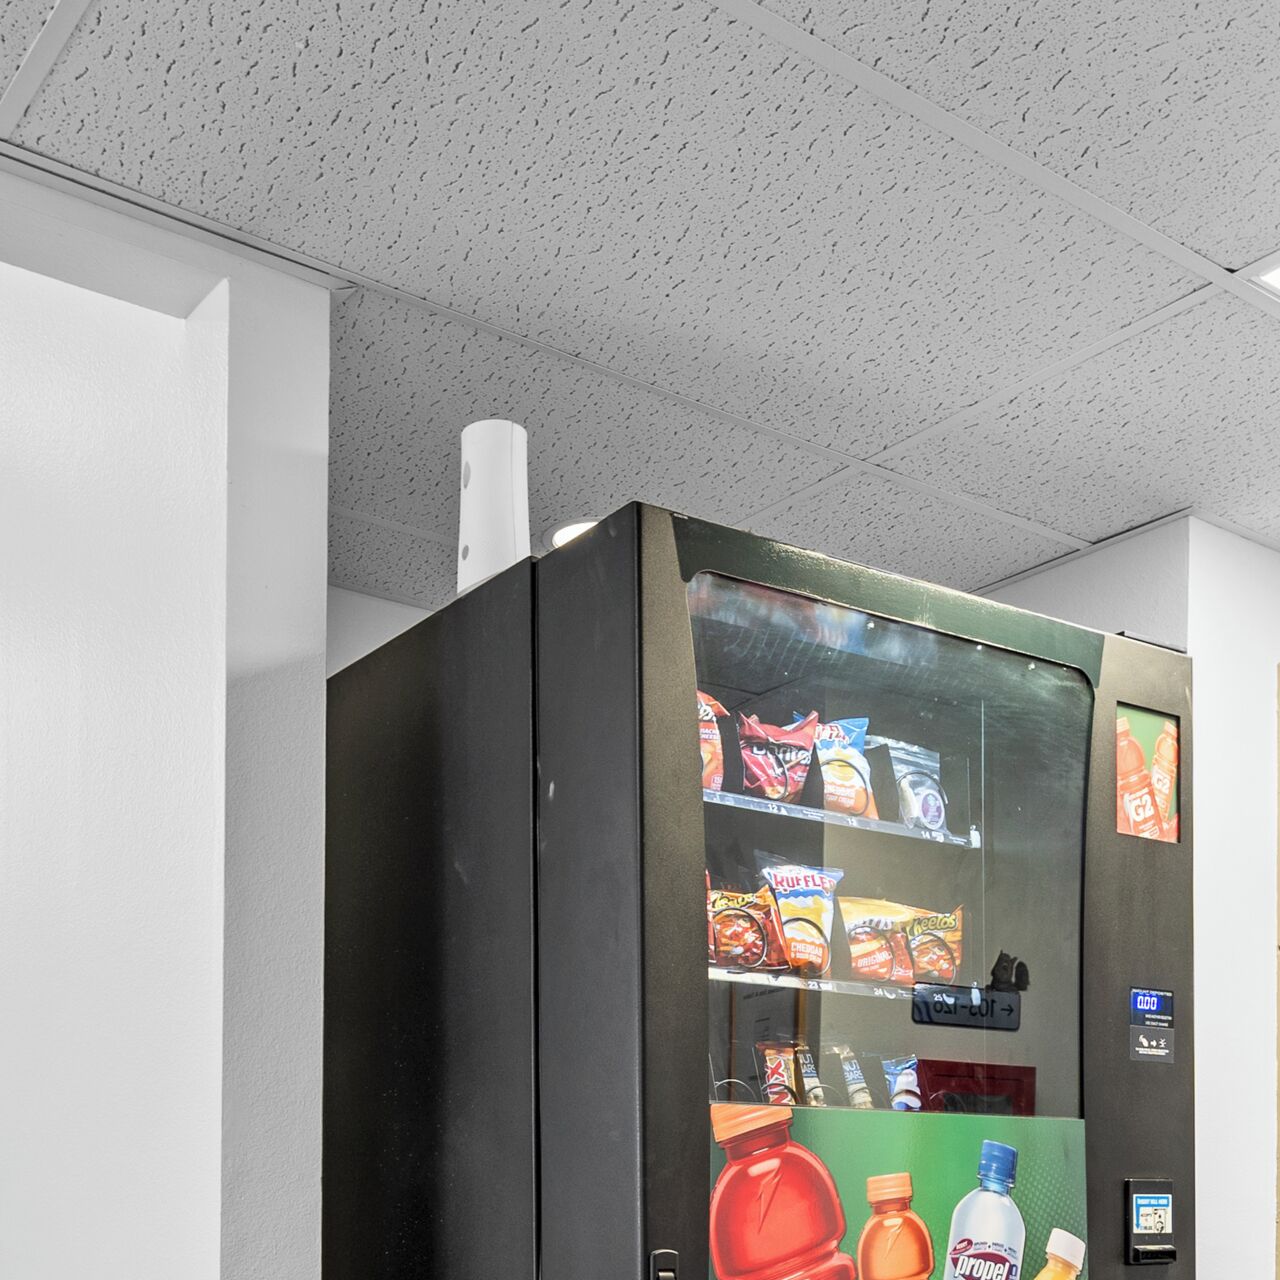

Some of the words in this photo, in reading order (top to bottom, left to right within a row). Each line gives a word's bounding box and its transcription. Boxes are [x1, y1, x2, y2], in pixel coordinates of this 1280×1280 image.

[768, 804, 778, 812] 12
[1130, 793, 1155, 822] G2
[874, 988, 883, 996] 24
[842, 1058, 860, 1071] NUT
[844, 1069, 864, 1081] BARS
